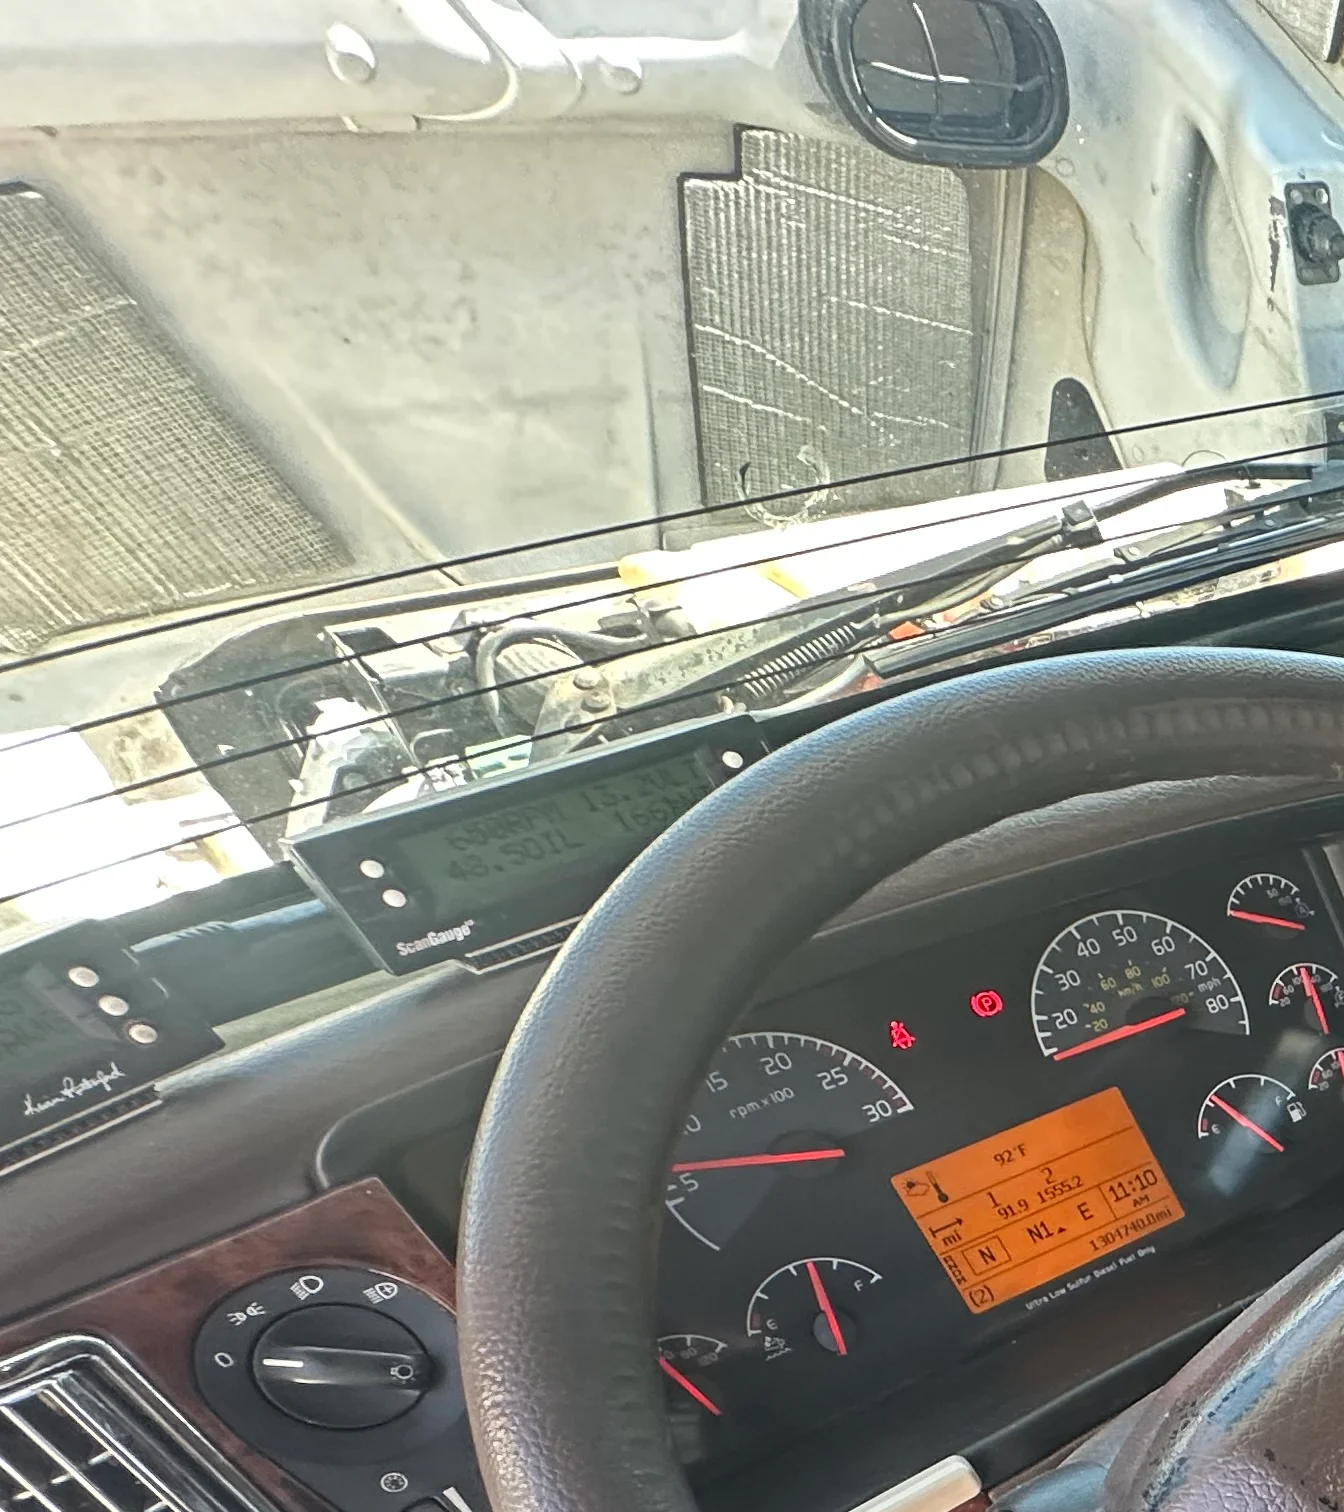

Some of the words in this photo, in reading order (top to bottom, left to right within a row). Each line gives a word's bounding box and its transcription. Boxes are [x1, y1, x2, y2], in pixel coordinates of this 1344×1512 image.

[1112, 926, 1138, 946] 50
[1151, 935, 1175, 956] 60
[1076, 938, 1101, 957] 40
[1054, 969, 1080, 991] 30
[1124, 966, 1141, 980] 80
[1184, 960, 1208, 980] 70
[1100, 977, 1117, 991] 60
[1197, 977, 1221, 993] mph
[1089, 1002, 1105, 1014] 40
[1205, 994, 1229, 1014] 80
[1052, 1008, 1078, 1030] 20
[1091, 1019, 1108, 1032] 20
[760, 1052, 792, 1076] 20
[705, 1071, 728, 1092] 15
[816, 1067, 848, 1090] 25
[862, 1100, 892, 1123] 30
[679, 1173, 699, 1192] 5
[1040, 1167, 1056, 1185] 2
[1108, 1168, 1158, 1203] 11:10
[986, 1191, 1000, 1208] 1
[997, 1199, 1029, 1221] 91.9
[1036, 1175, 1083, 1204] 1555.2
[1132, 1194, 1150, 1208] AM
[1077, 1202, 1094, 1221] E
[942, 1230, 962, 1247] mi
[980, 1245, 997, 1266] N
[854, 1279, 864, 1291] F
[1025, 1294, 1049, 1311] Ultra
[1049, 1287, 1067, 1300] Low
[1094, 1262, 1117, 1278] Diesel
[1118, 1253, 1136, 1267] Fuel
[1137, 1245, 1156, 1261] Only
[969, 1285, 995, 1308] (2)
